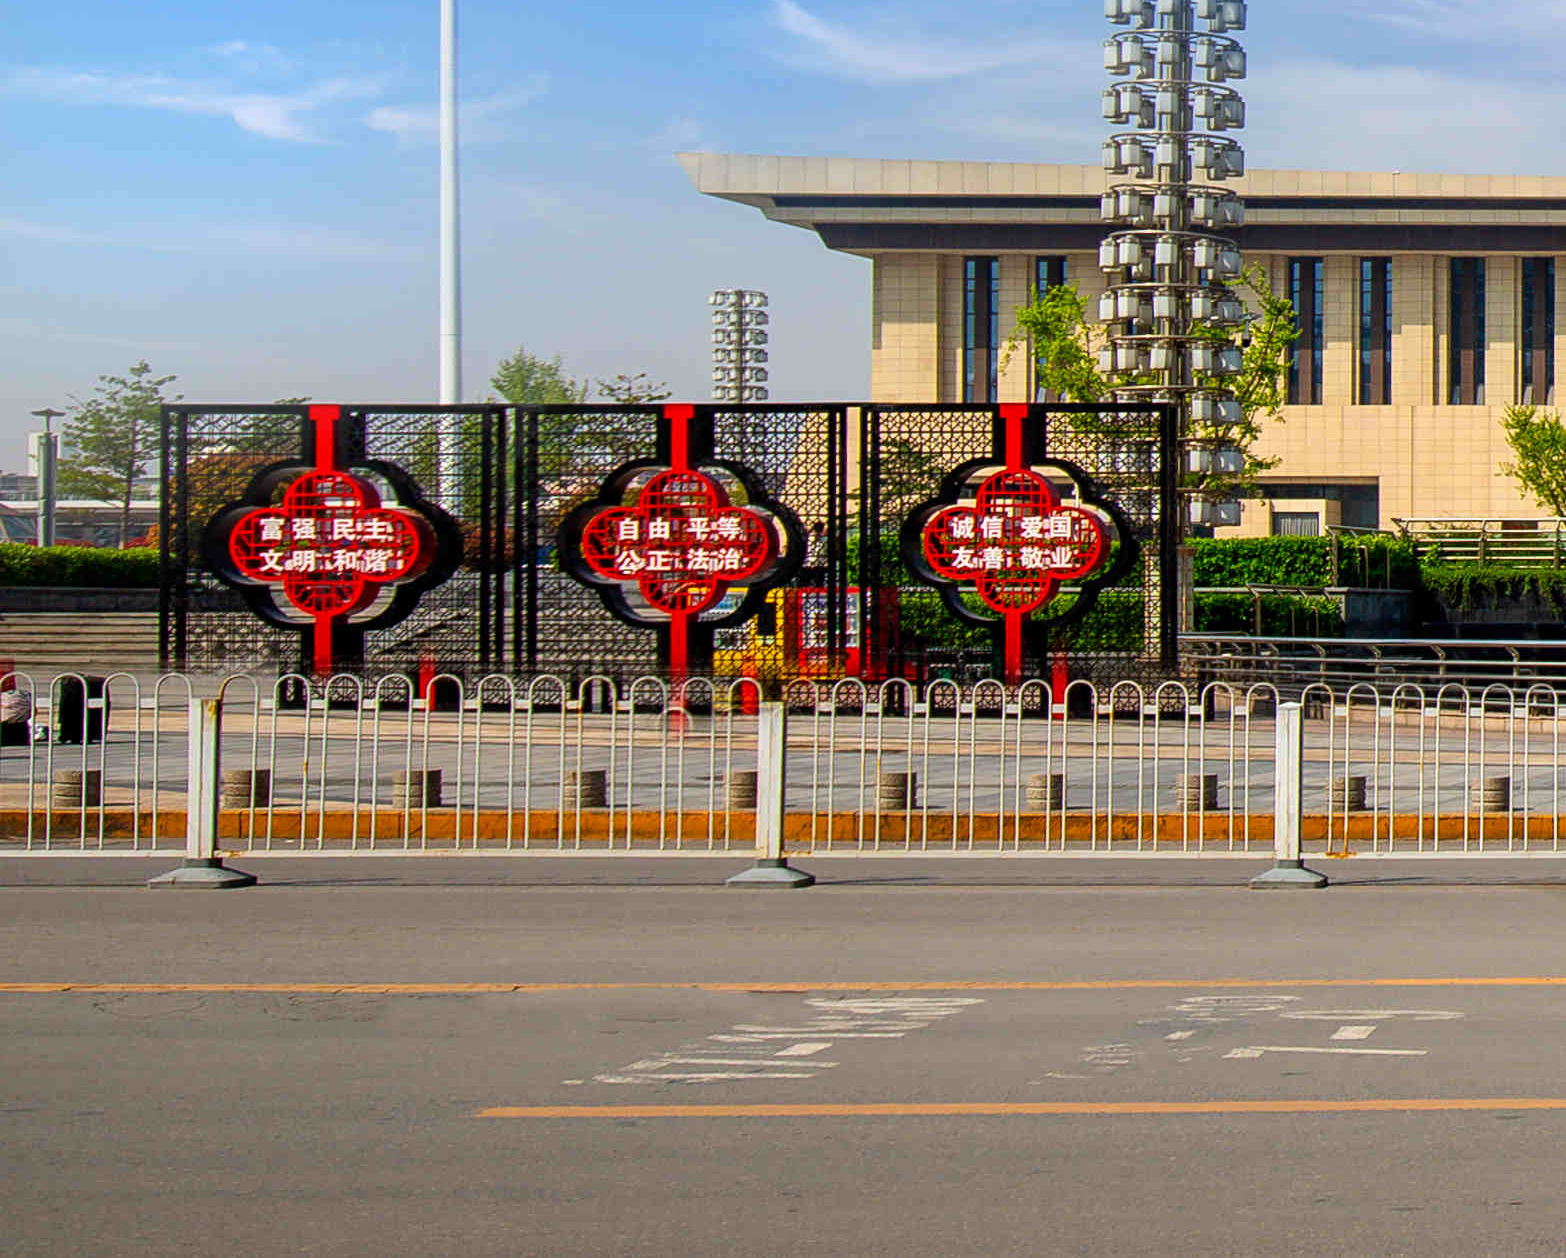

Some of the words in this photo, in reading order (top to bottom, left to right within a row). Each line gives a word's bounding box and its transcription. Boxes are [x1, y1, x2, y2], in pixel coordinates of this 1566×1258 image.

[259, 517, 316, 541] 富强
[332, 517, 390, 541] 民主
[618, 517, 670, 541] 自由
[686, 516, 742, 540] 平等
[952, 516, 1004, 539] 诚信
[1020, 515, 1072, 539] 爱国
[259, 549, 316, 572] 文明
[331, 549, 390, 573] 和谐
[616, 549, 671, 574] 公正
[687, 548, 740, 571] 法治
[951, 546, 1004, 569] 友善
[1020, 545, 1073, 569] 敬业
